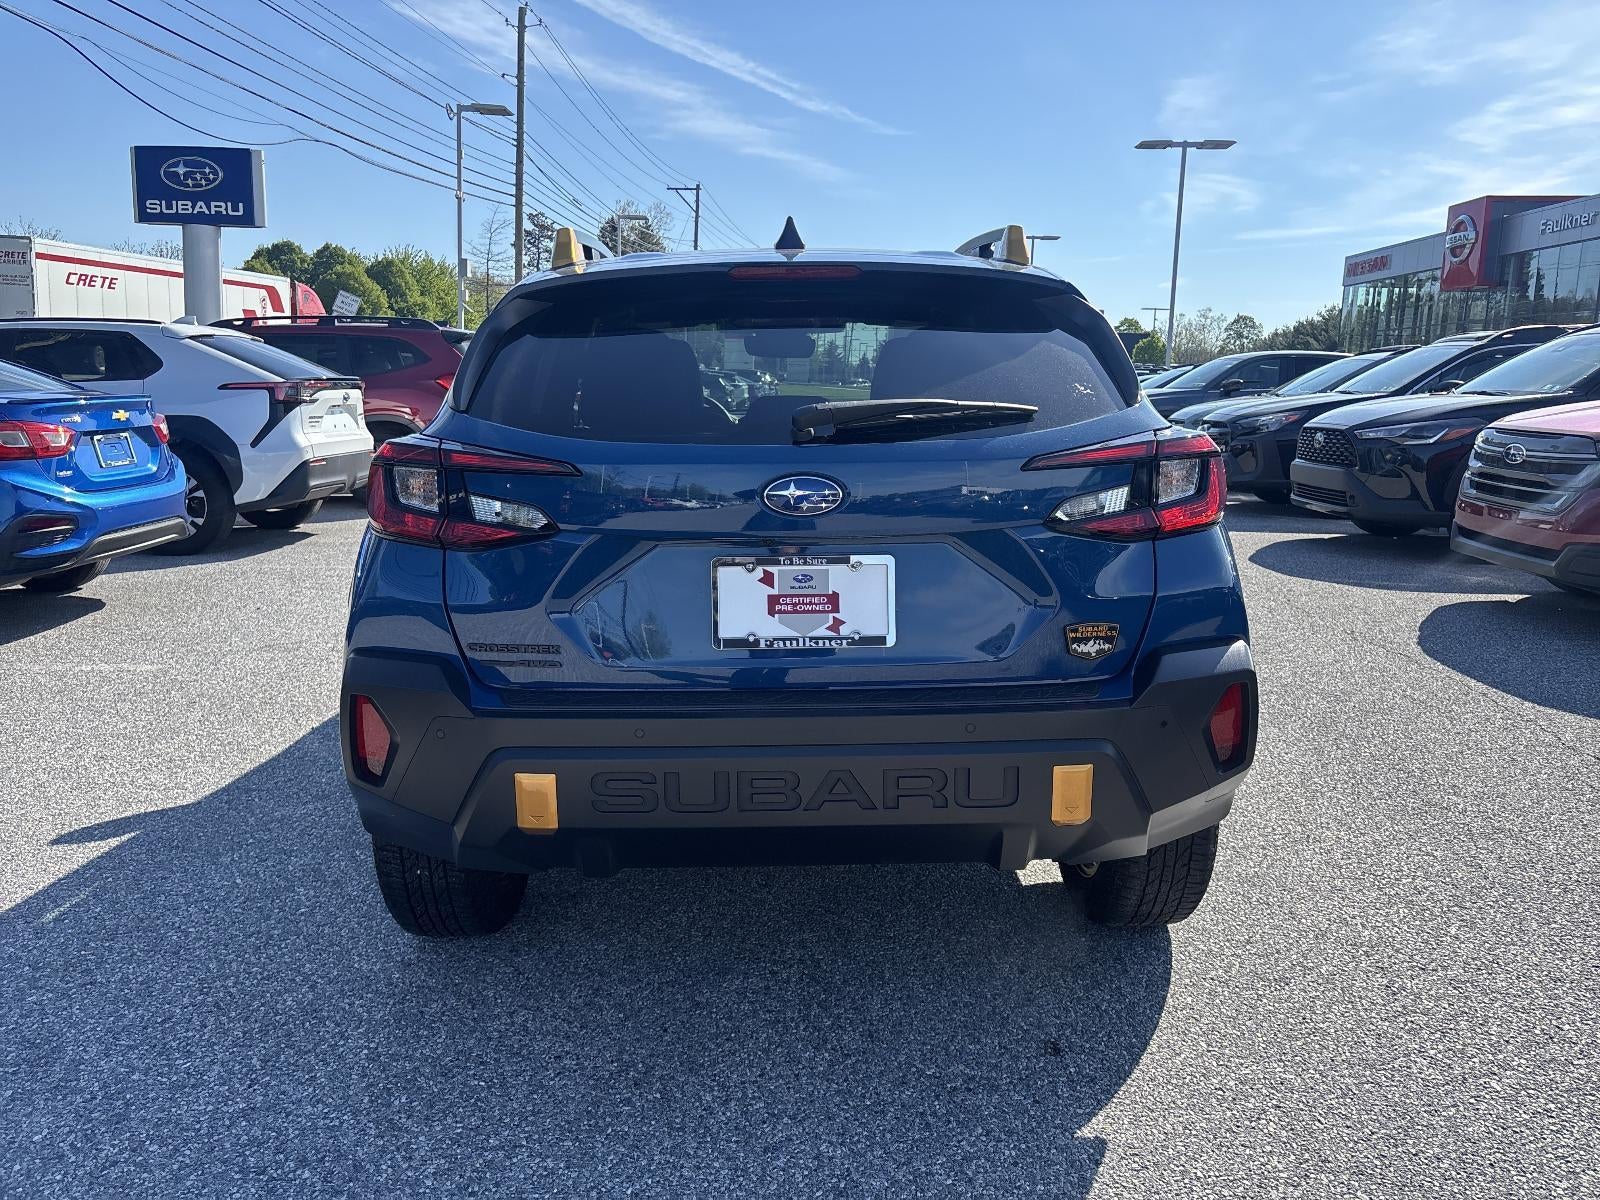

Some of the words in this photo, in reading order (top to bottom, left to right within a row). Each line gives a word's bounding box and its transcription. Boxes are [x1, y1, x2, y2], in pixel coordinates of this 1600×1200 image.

[146, 199, 244, 216] SUBARU
[1540, 211, 1599, 235] Faulkner
[65, 271, 119, 290] CRETE
[779, 557, 790, 566] To
[793, 557, 805, 566] Be
[806, 557, 828, 566] Sure
[779, 596, 828, 604] CERTIFIED
[775, 604, 832, 612] PRE-OWNED
[1069, 630, 1117, 638] WILDERNESS
[1078, 625, 1109, 633] SUBARU
[466, 642, 562, 655] CROSSTREK
[758, 637, 852, 649] Faulkner
[590, 766, 1021, 814] SUBARU
